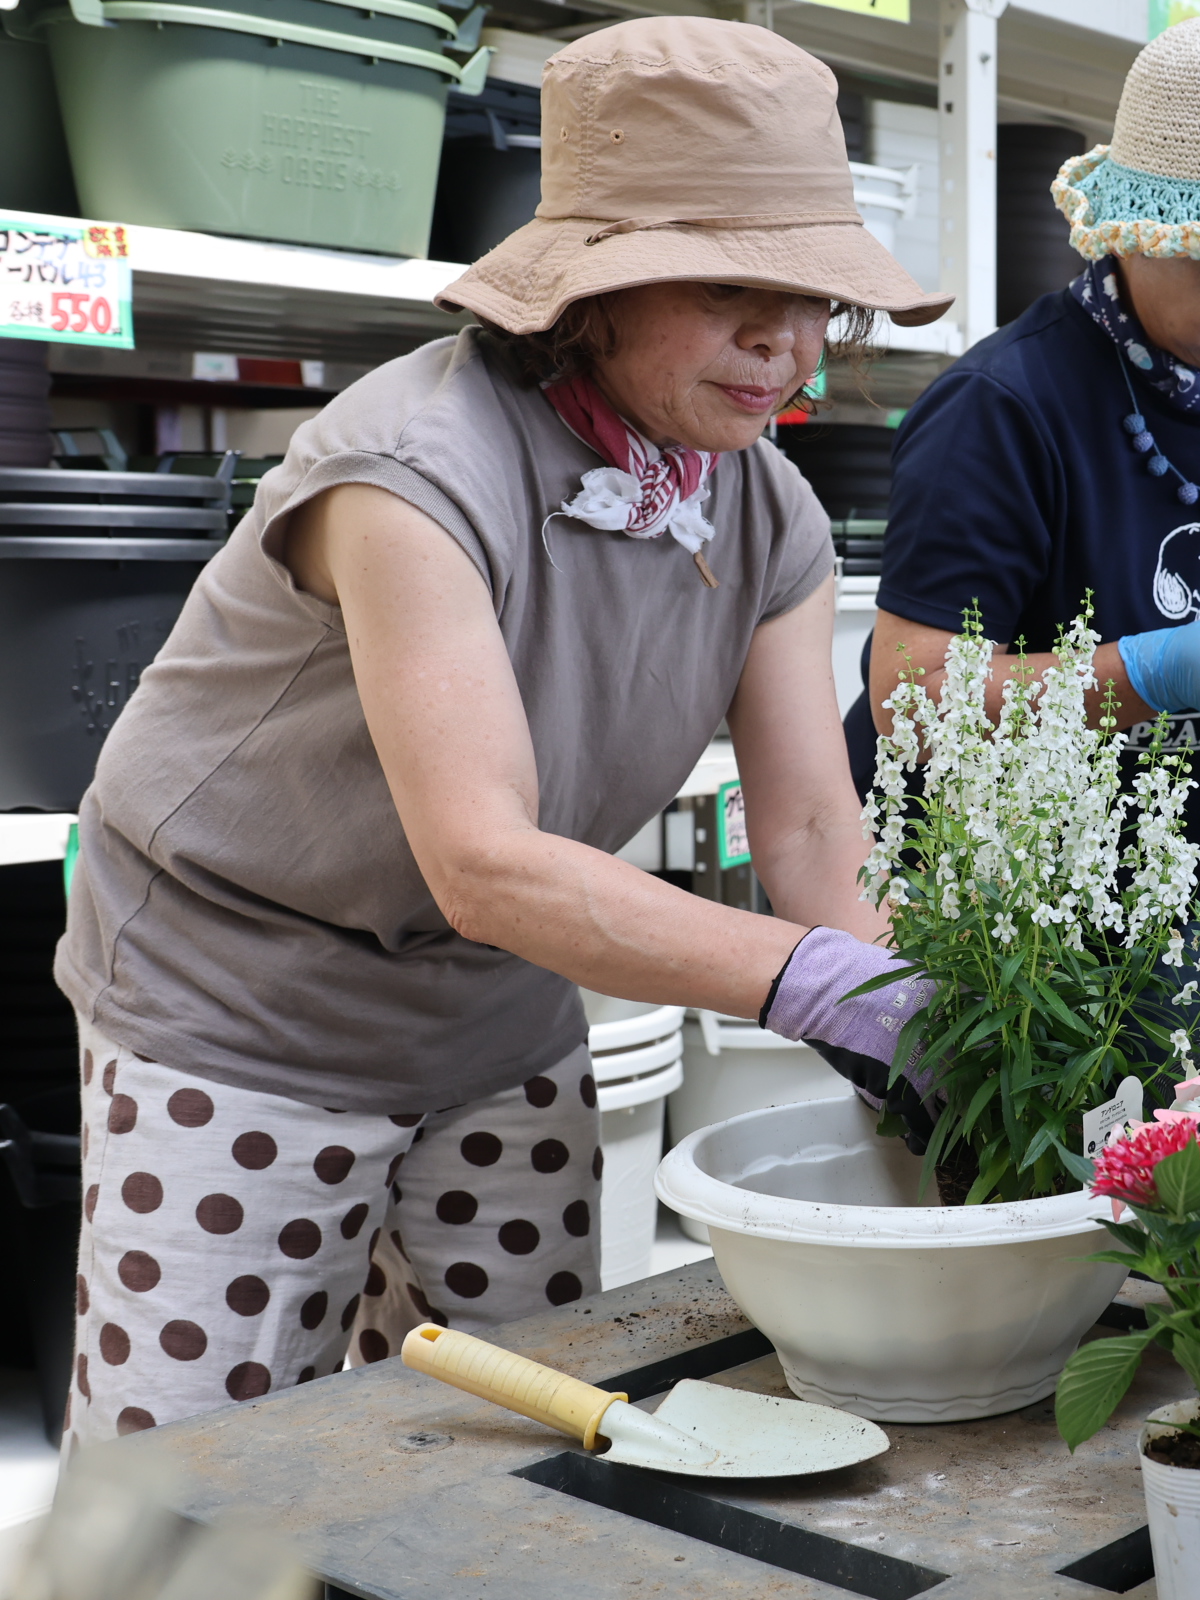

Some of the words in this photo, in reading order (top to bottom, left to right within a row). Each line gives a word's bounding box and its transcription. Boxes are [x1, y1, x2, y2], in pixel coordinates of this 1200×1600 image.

[299, 80, 341, 118] THE
[261, 111, 371, 160] HAPPIEST
[280, 152, 348, 193] OASIS
[51, 292, 112, 334] 550
